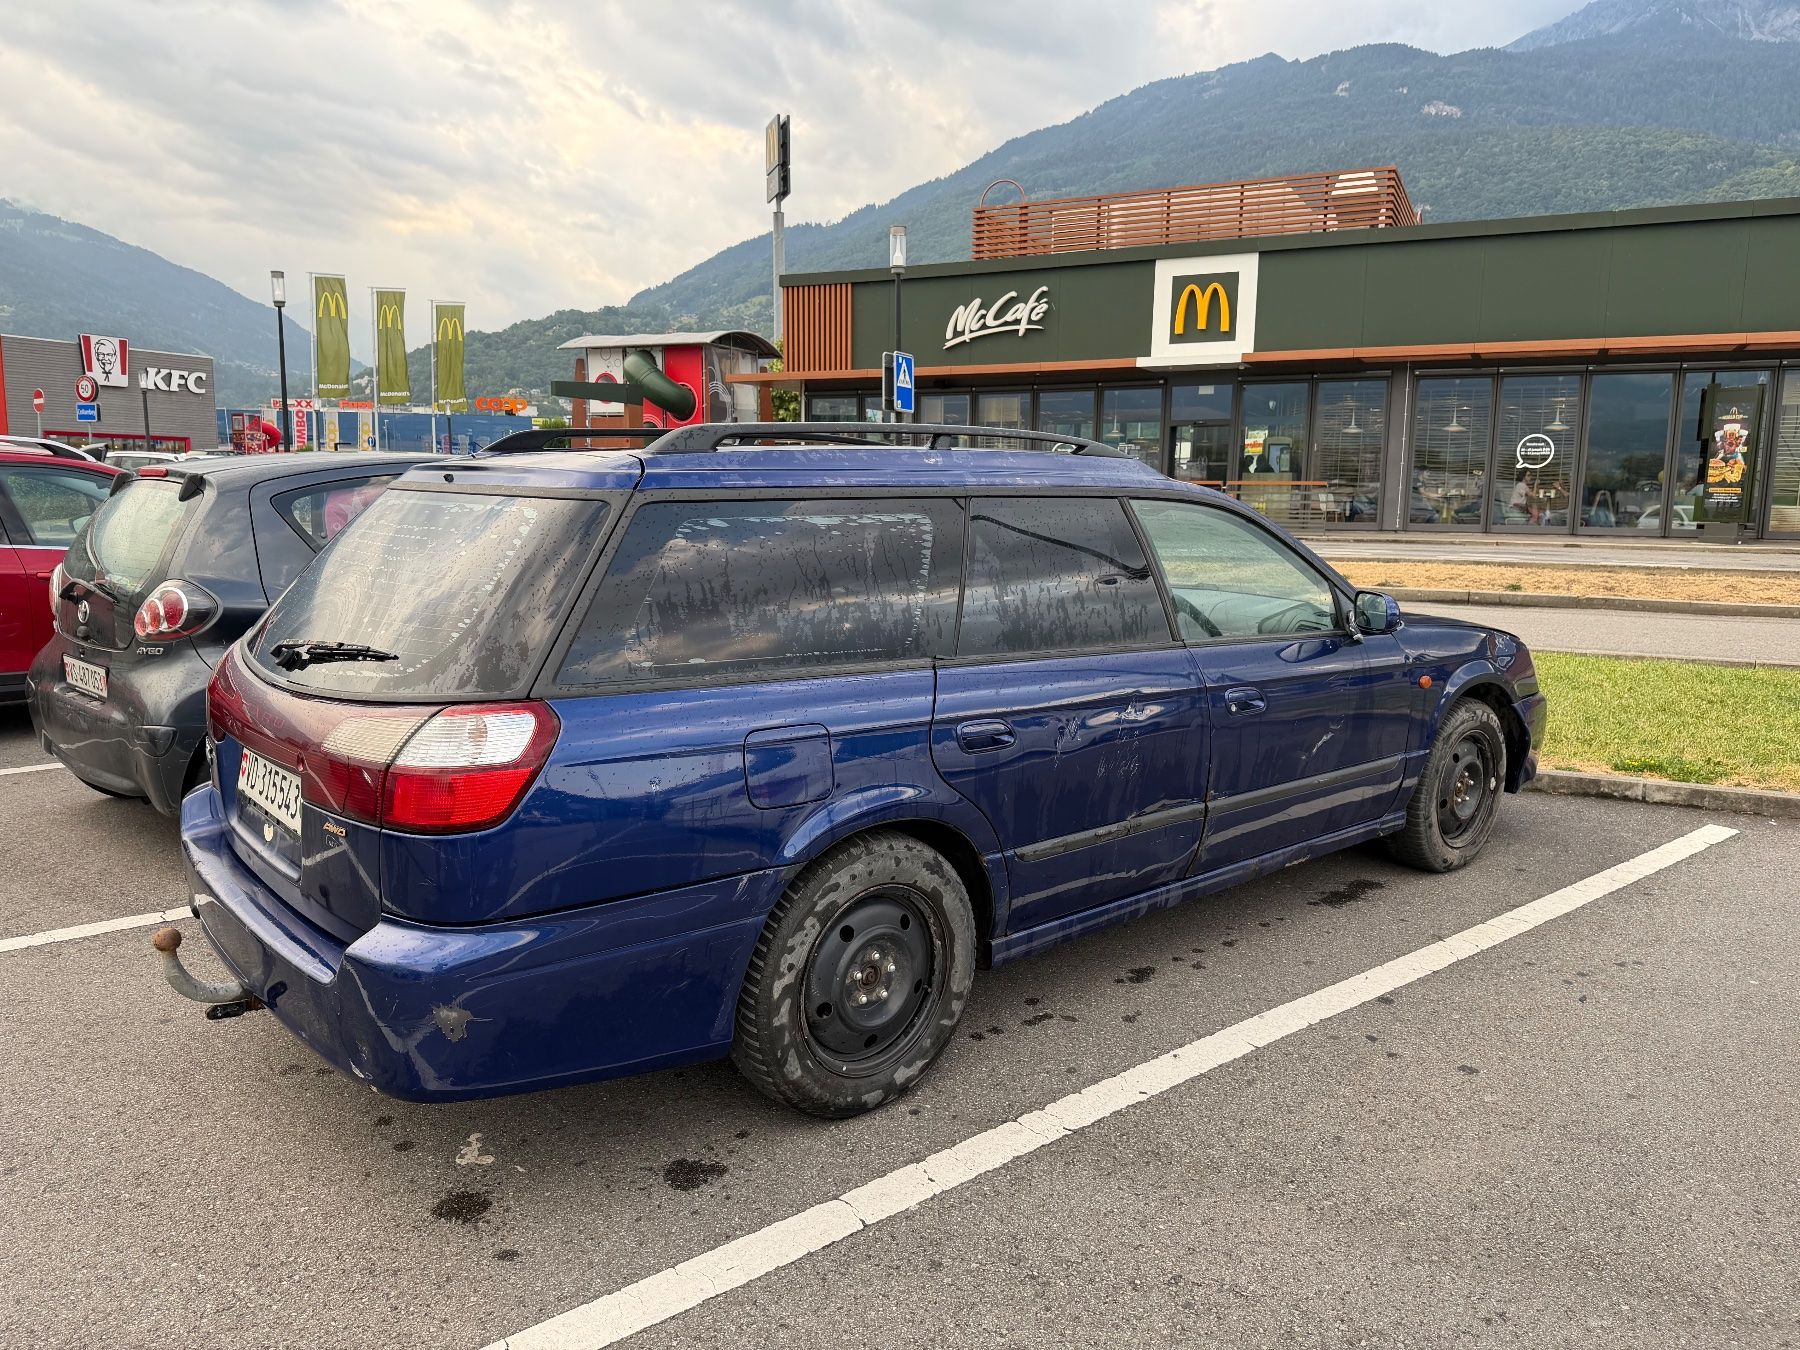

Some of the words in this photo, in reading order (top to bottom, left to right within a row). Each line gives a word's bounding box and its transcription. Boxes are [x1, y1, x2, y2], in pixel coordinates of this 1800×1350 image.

[943, 285, 1049, 349] McCafé
[80, 384, 89, 394] 50
[146, 366, 207, 394] KFC
[295, 410, 307, 449] UMBO
[136, 646, 164, 655] AYGO
[322, 820, 348, 838] AWD
